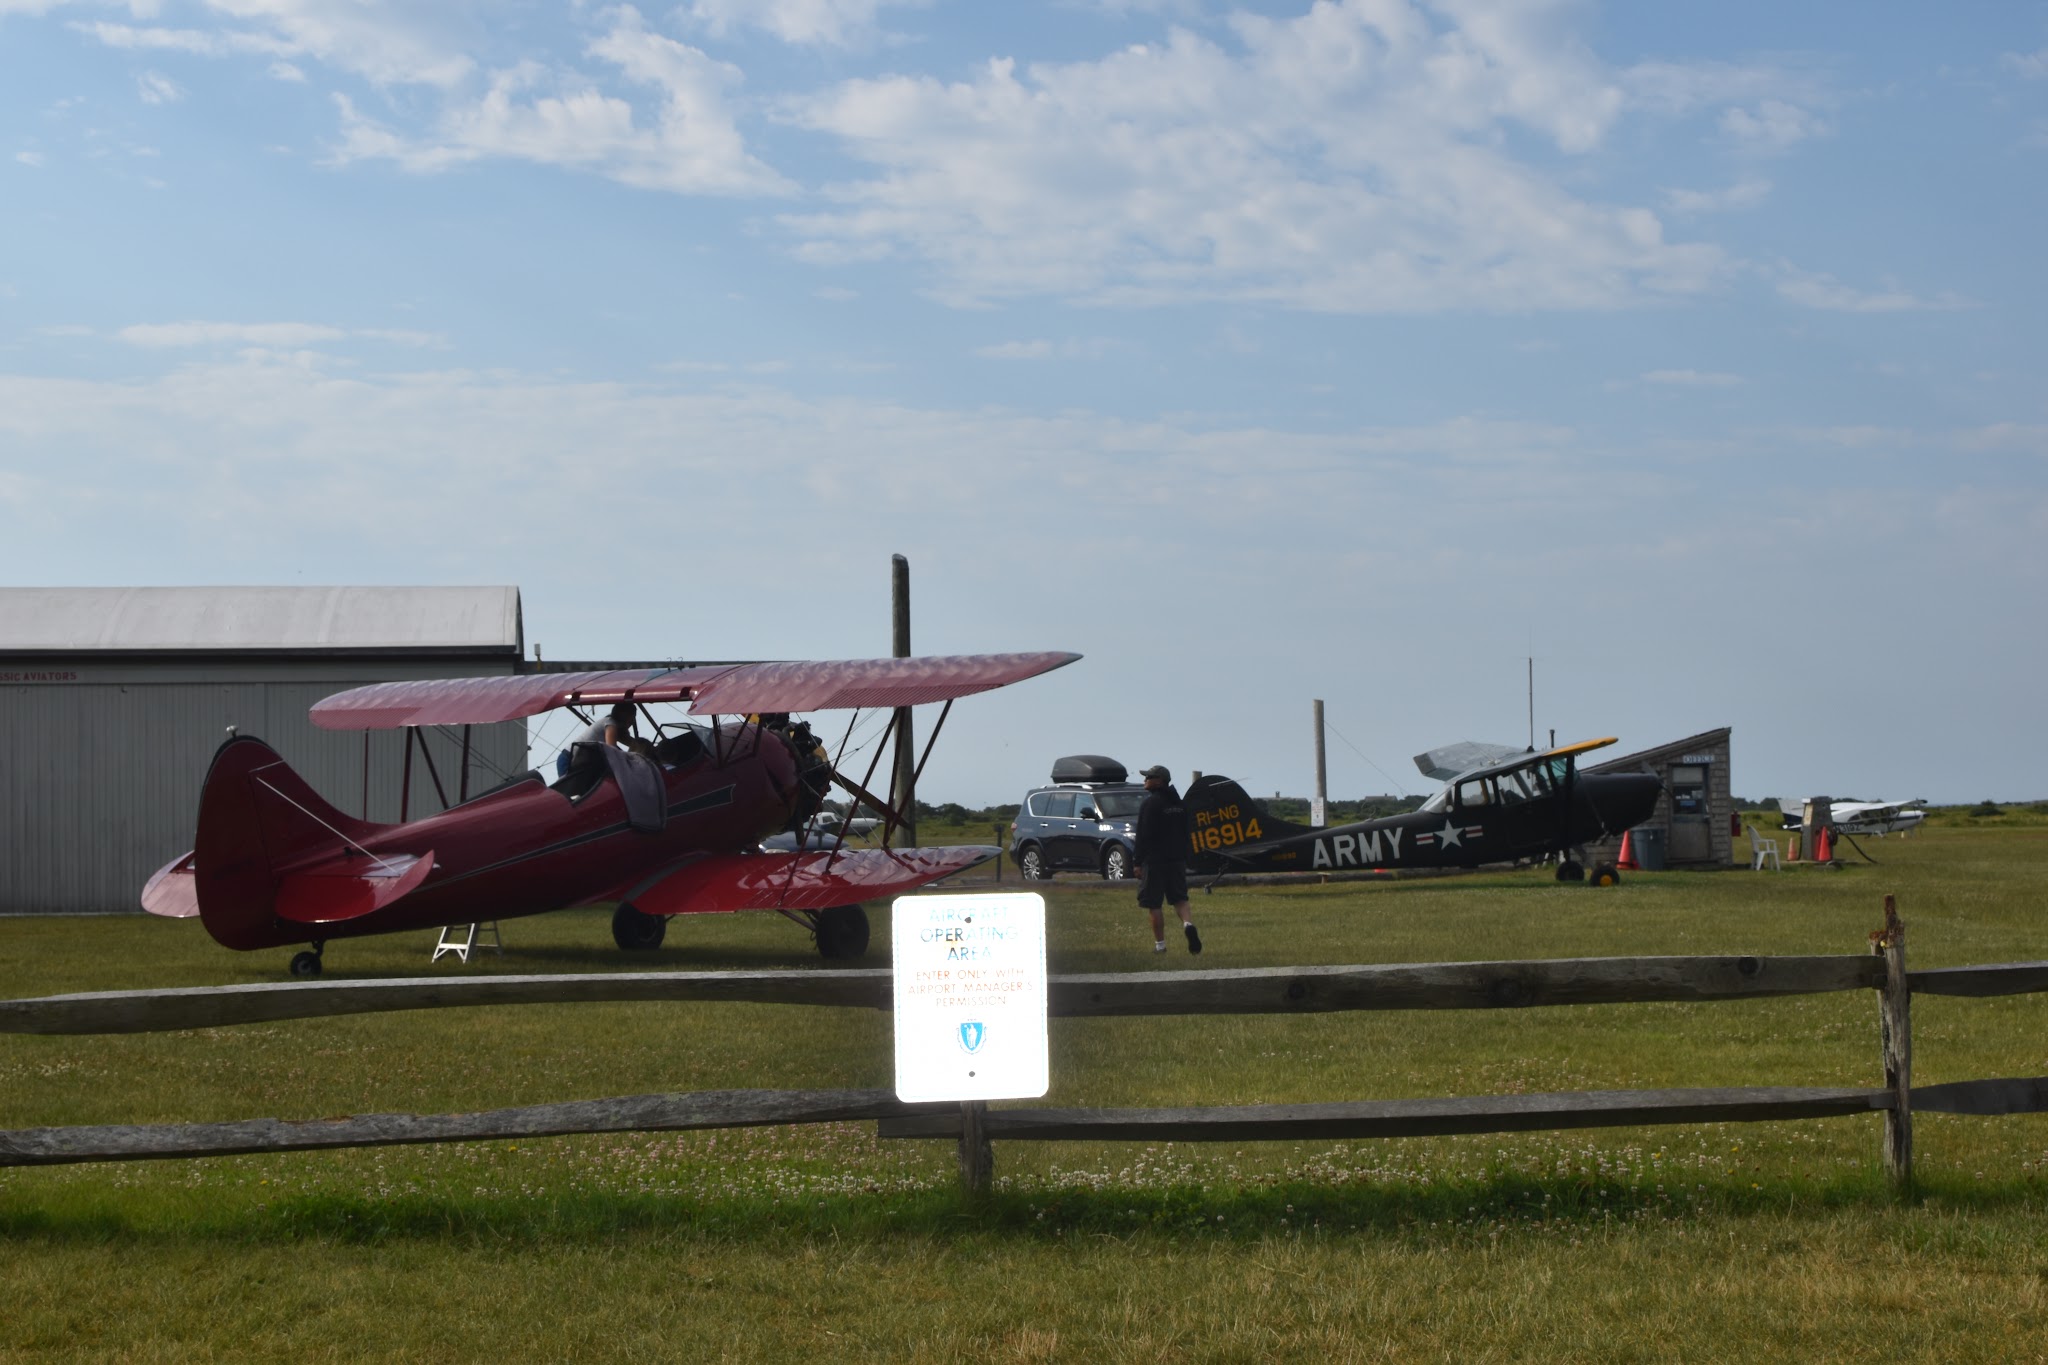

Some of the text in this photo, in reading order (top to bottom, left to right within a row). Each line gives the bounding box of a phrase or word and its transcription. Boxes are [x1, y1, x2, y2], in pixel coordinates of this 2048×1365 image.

[23, 671, 77, 681] AVIATORS
[1683, 755, 1715, 763] OFFICE
[1196, 804, 1239, 827] RI-NG
[1190, 818, 1262, 853] 116914
[1312, 827, 1403, 869] ARMY
[929, 906, 1008, 922] AIRCRAFT
[920, 926, 1018, 943] OPERATING
[947, 946, 992, 961] AREA
[917, 967, 1024, 981] ENTER ONLY WITH
[908, 981, 1033, 995] AIRPORT MANAGERS
[936, 996, 1006, 1007] PERMISSION
